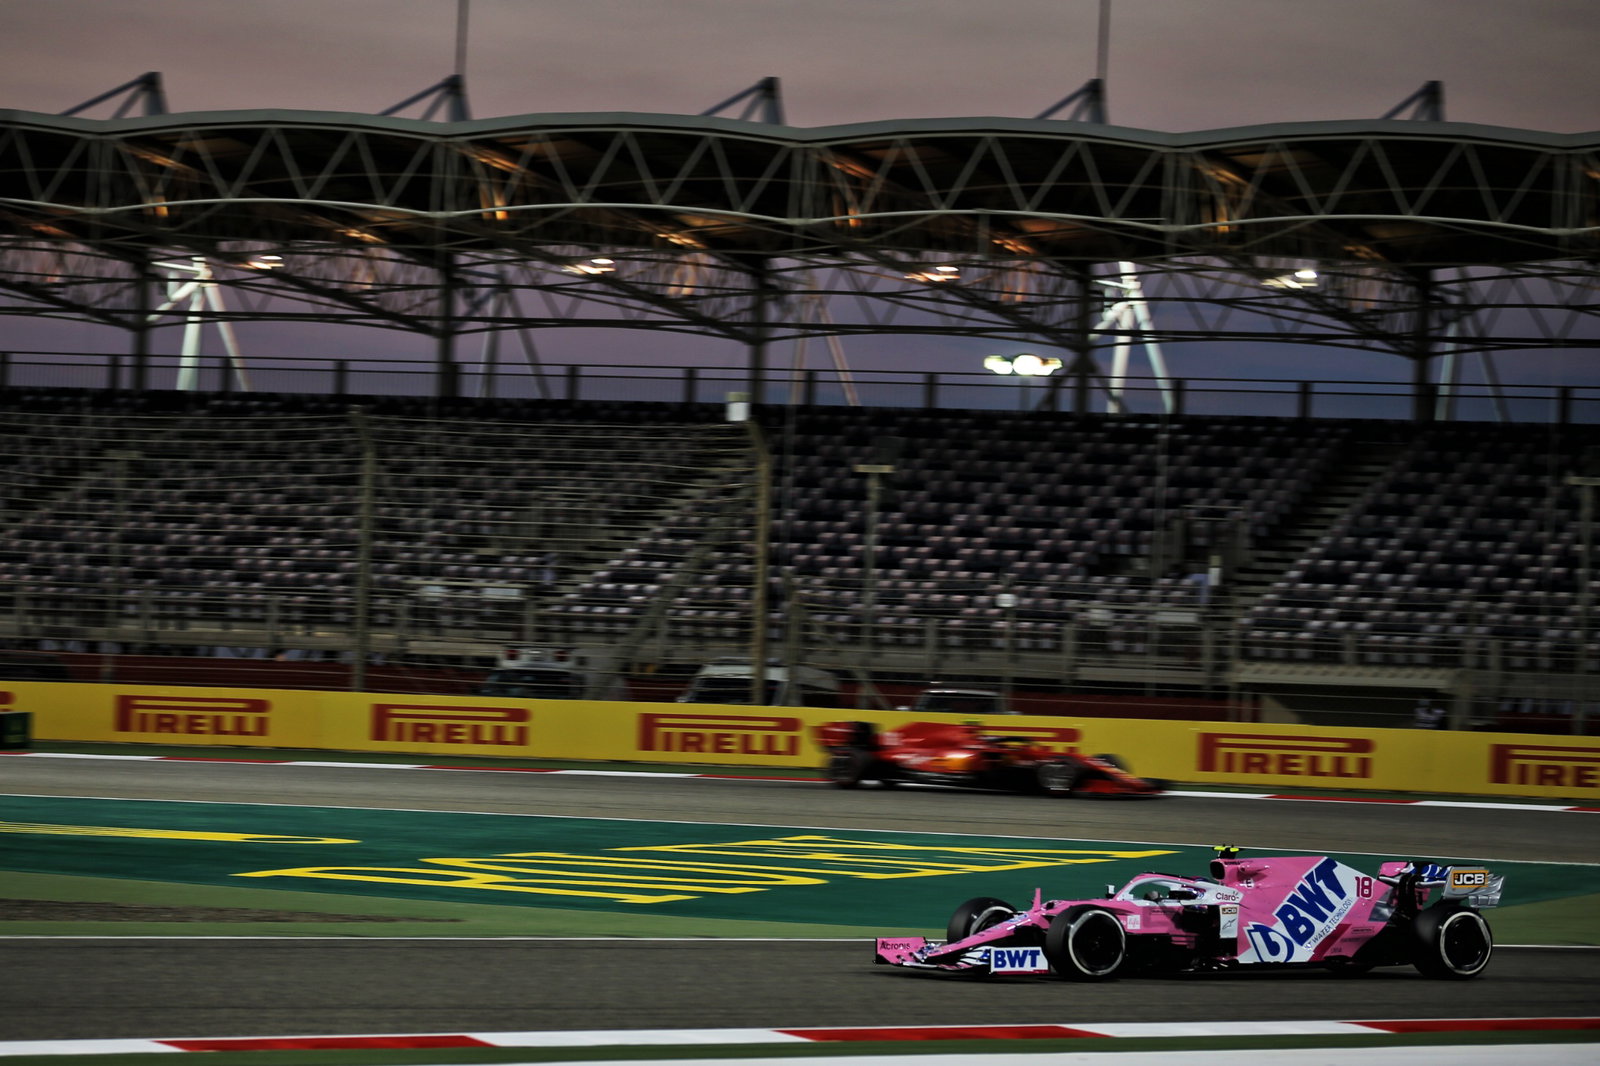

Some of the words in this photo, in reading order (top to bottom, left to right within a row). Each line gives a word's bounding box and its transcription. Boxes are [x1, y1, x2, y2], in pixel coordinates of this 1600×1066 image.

[115, 695, 271, 736] PIRELLI
[371, 704, 531, 746] PIRELLI
[638, 713, 803, 755] PIRELLI
[1198, 732, 1374, 779] PIRELLI
[229, 835, 1181, 904] ROLEX
[1355, 876, 1373, 898] 18
[1454, 873, 1485, 885] JCB
[1216, 892, 1236, 901] Claro
[1276, 858, 1347, 947] BWT
[994, 950, 1040, 968] BWT
